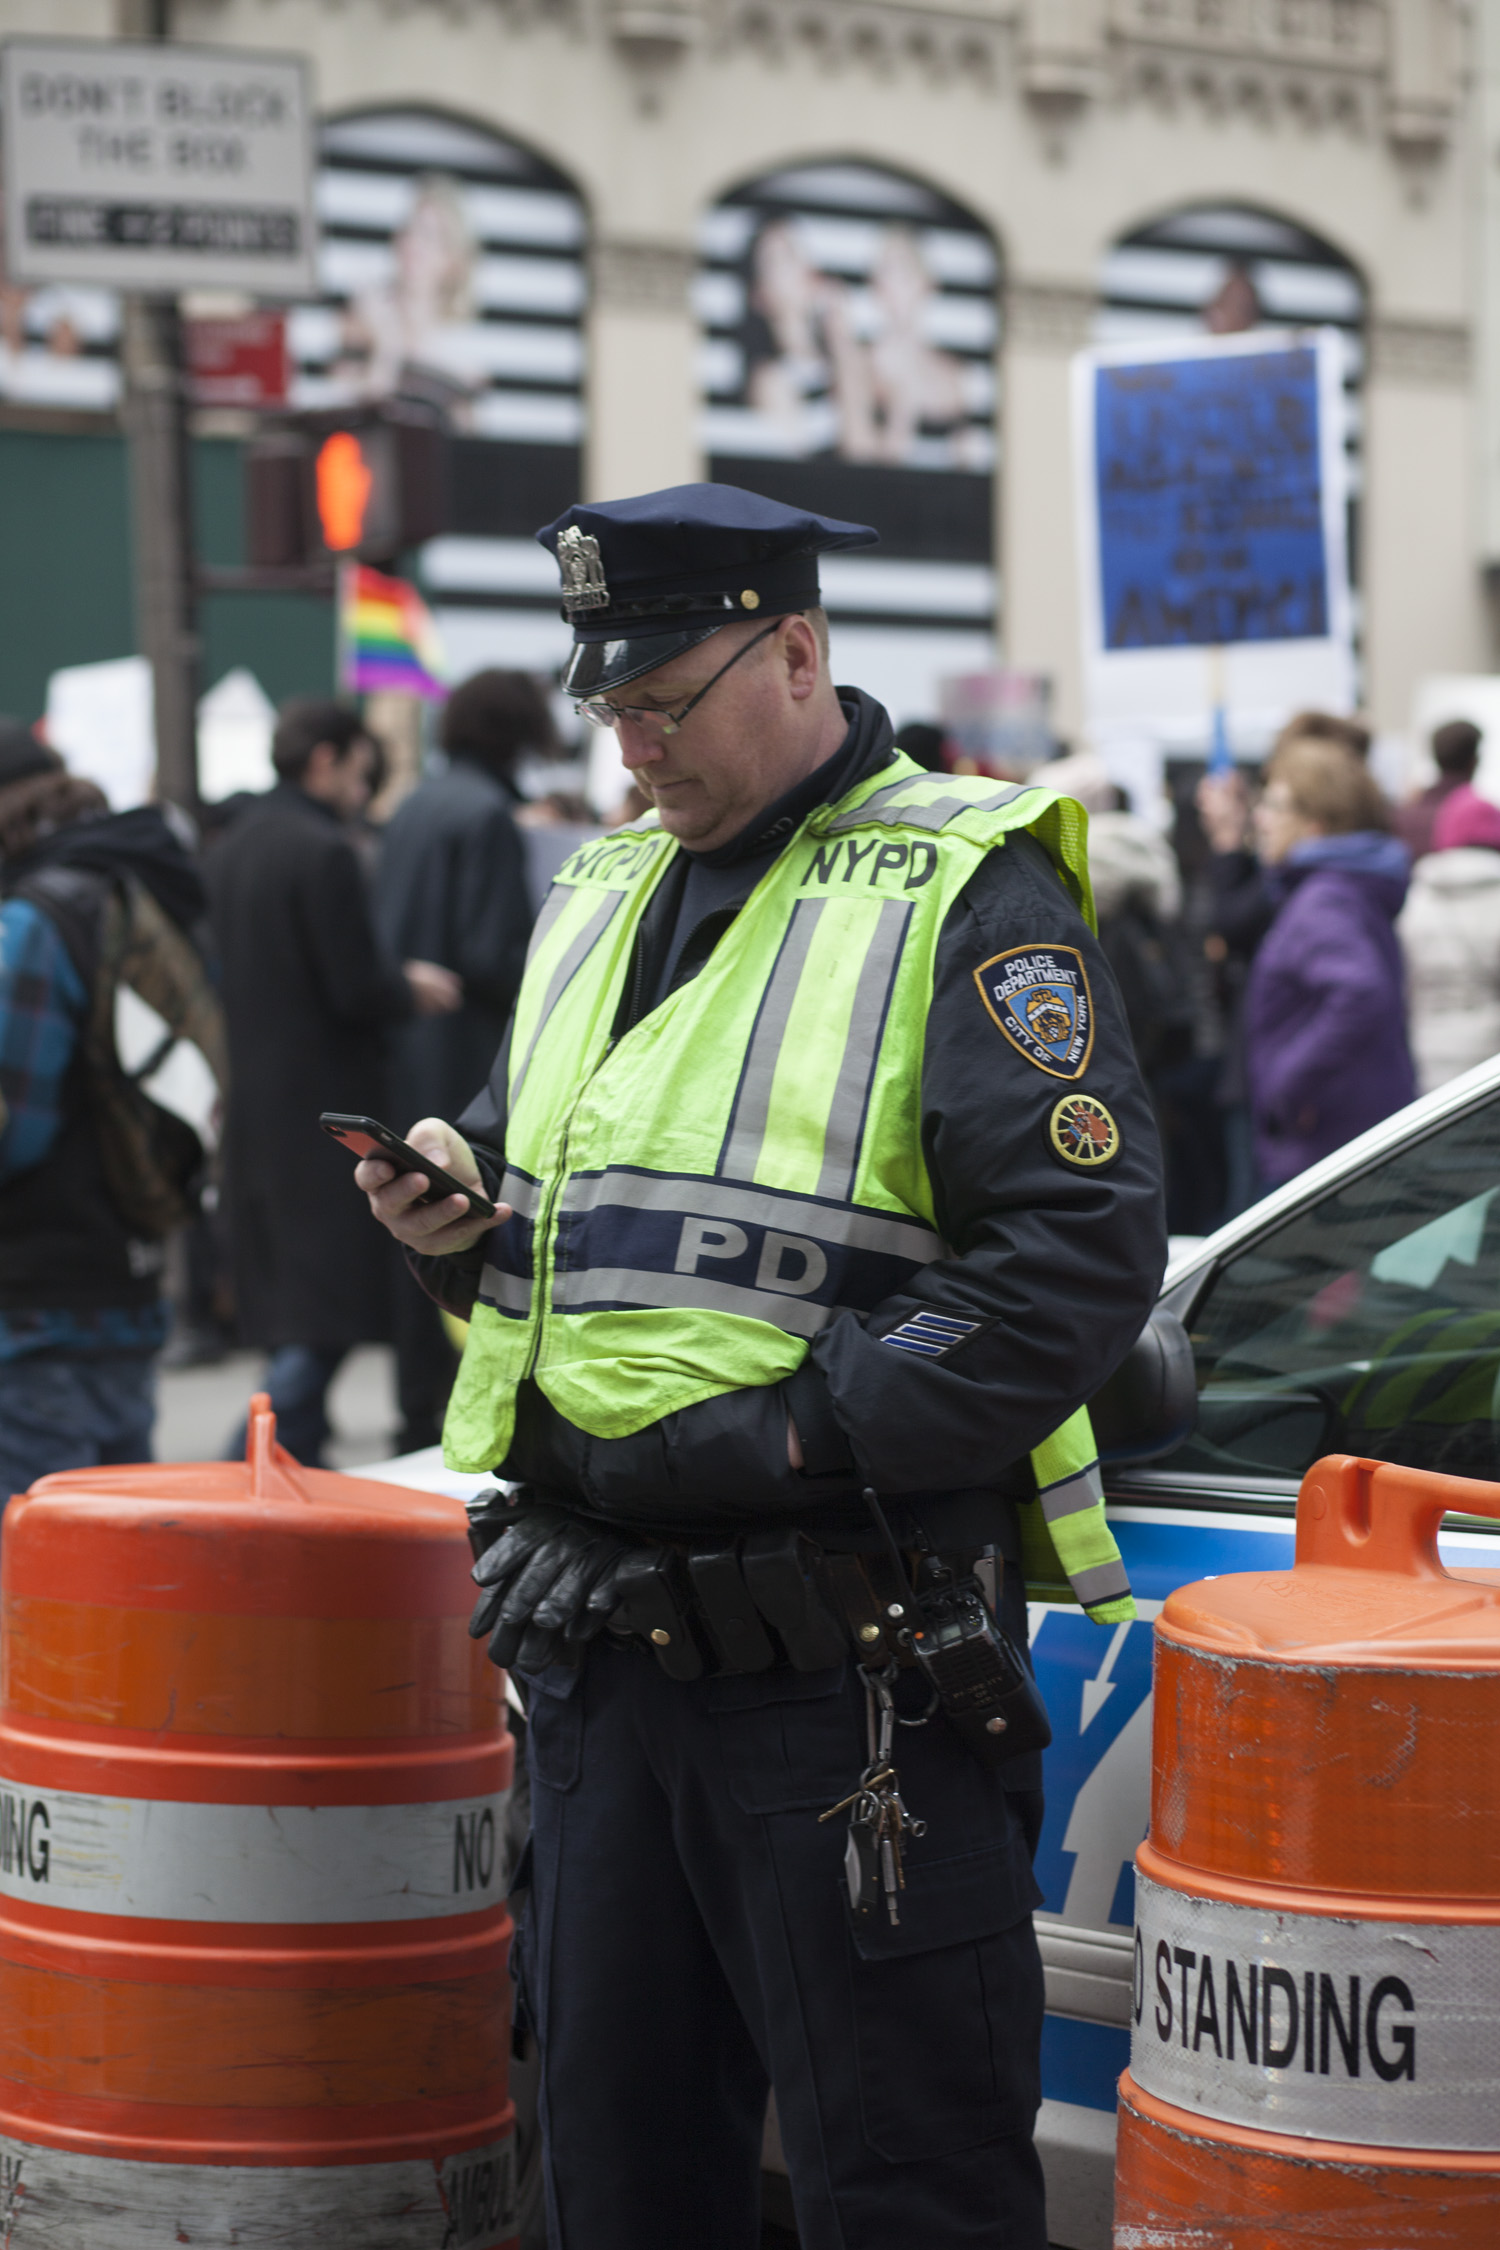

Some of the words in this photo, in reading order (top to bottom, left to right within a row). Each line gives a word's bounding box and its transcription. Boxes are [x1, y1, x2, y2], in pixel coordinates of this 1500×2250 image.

[22, 76, 143, 117] DON'T
[158, 83, 288, 127] BLOCK
[78, 128, 153, 169] THE
[170, 133, 246, 175] BOX
[560, 839, 660, 881] NYPD
[800, 839, 938, 890] NYPD
[993, 968, 1078, 1002] DEPARTMENT
[1004, 955, 1057, 977] POLICE
[1004, 1016, 1034, 1046] CITY
[1032, 1046, 1054, 1063] OF
[1066, 1034, 1086, 1064] NEW
[1076, 995, 1088, 1031] YORK
[674, 1216, 828, 1295] PD
[453, 1807, 495, 1893] NO
[1155, 1939, 1416, 2082] STANDING
